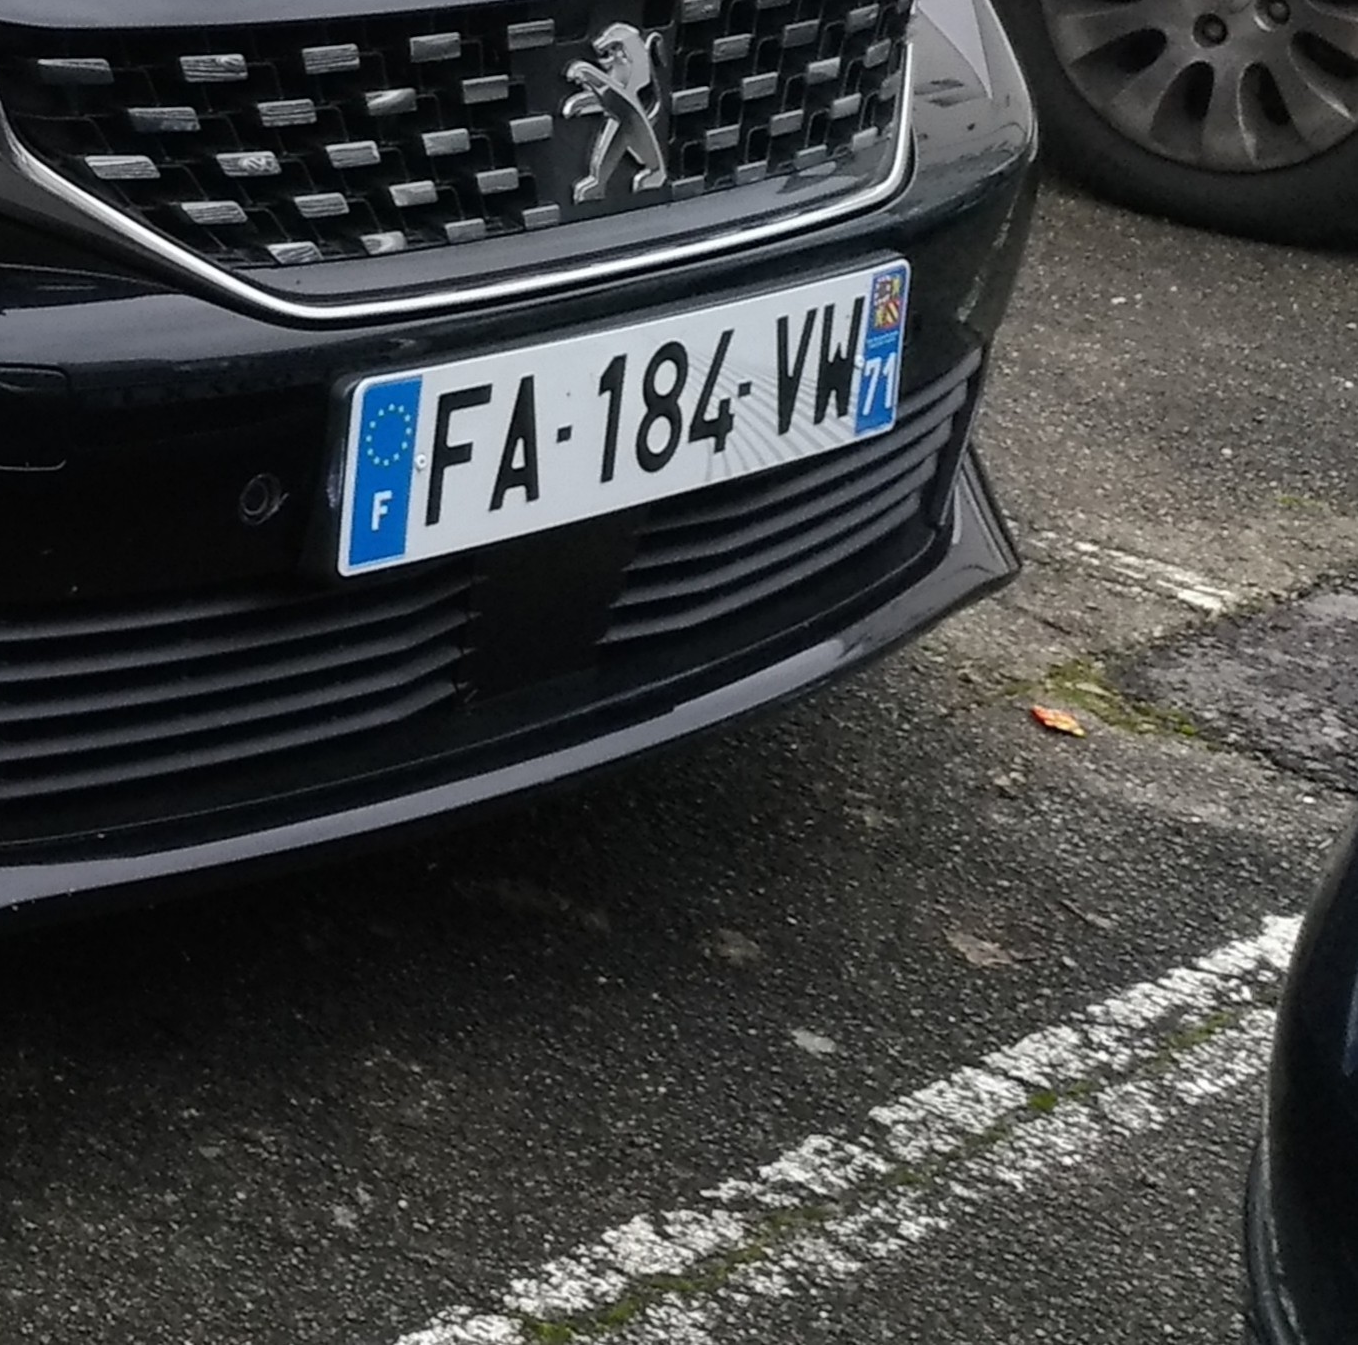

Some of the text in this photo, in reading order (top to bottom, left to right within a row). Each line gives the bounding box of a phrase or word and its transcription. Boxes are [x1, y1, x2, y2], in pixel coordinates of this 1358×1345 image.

[425, 296, 866, 527] FA-184-VW
[862, 351, 896, 416] 71
[371, 489, 393, 531] F
